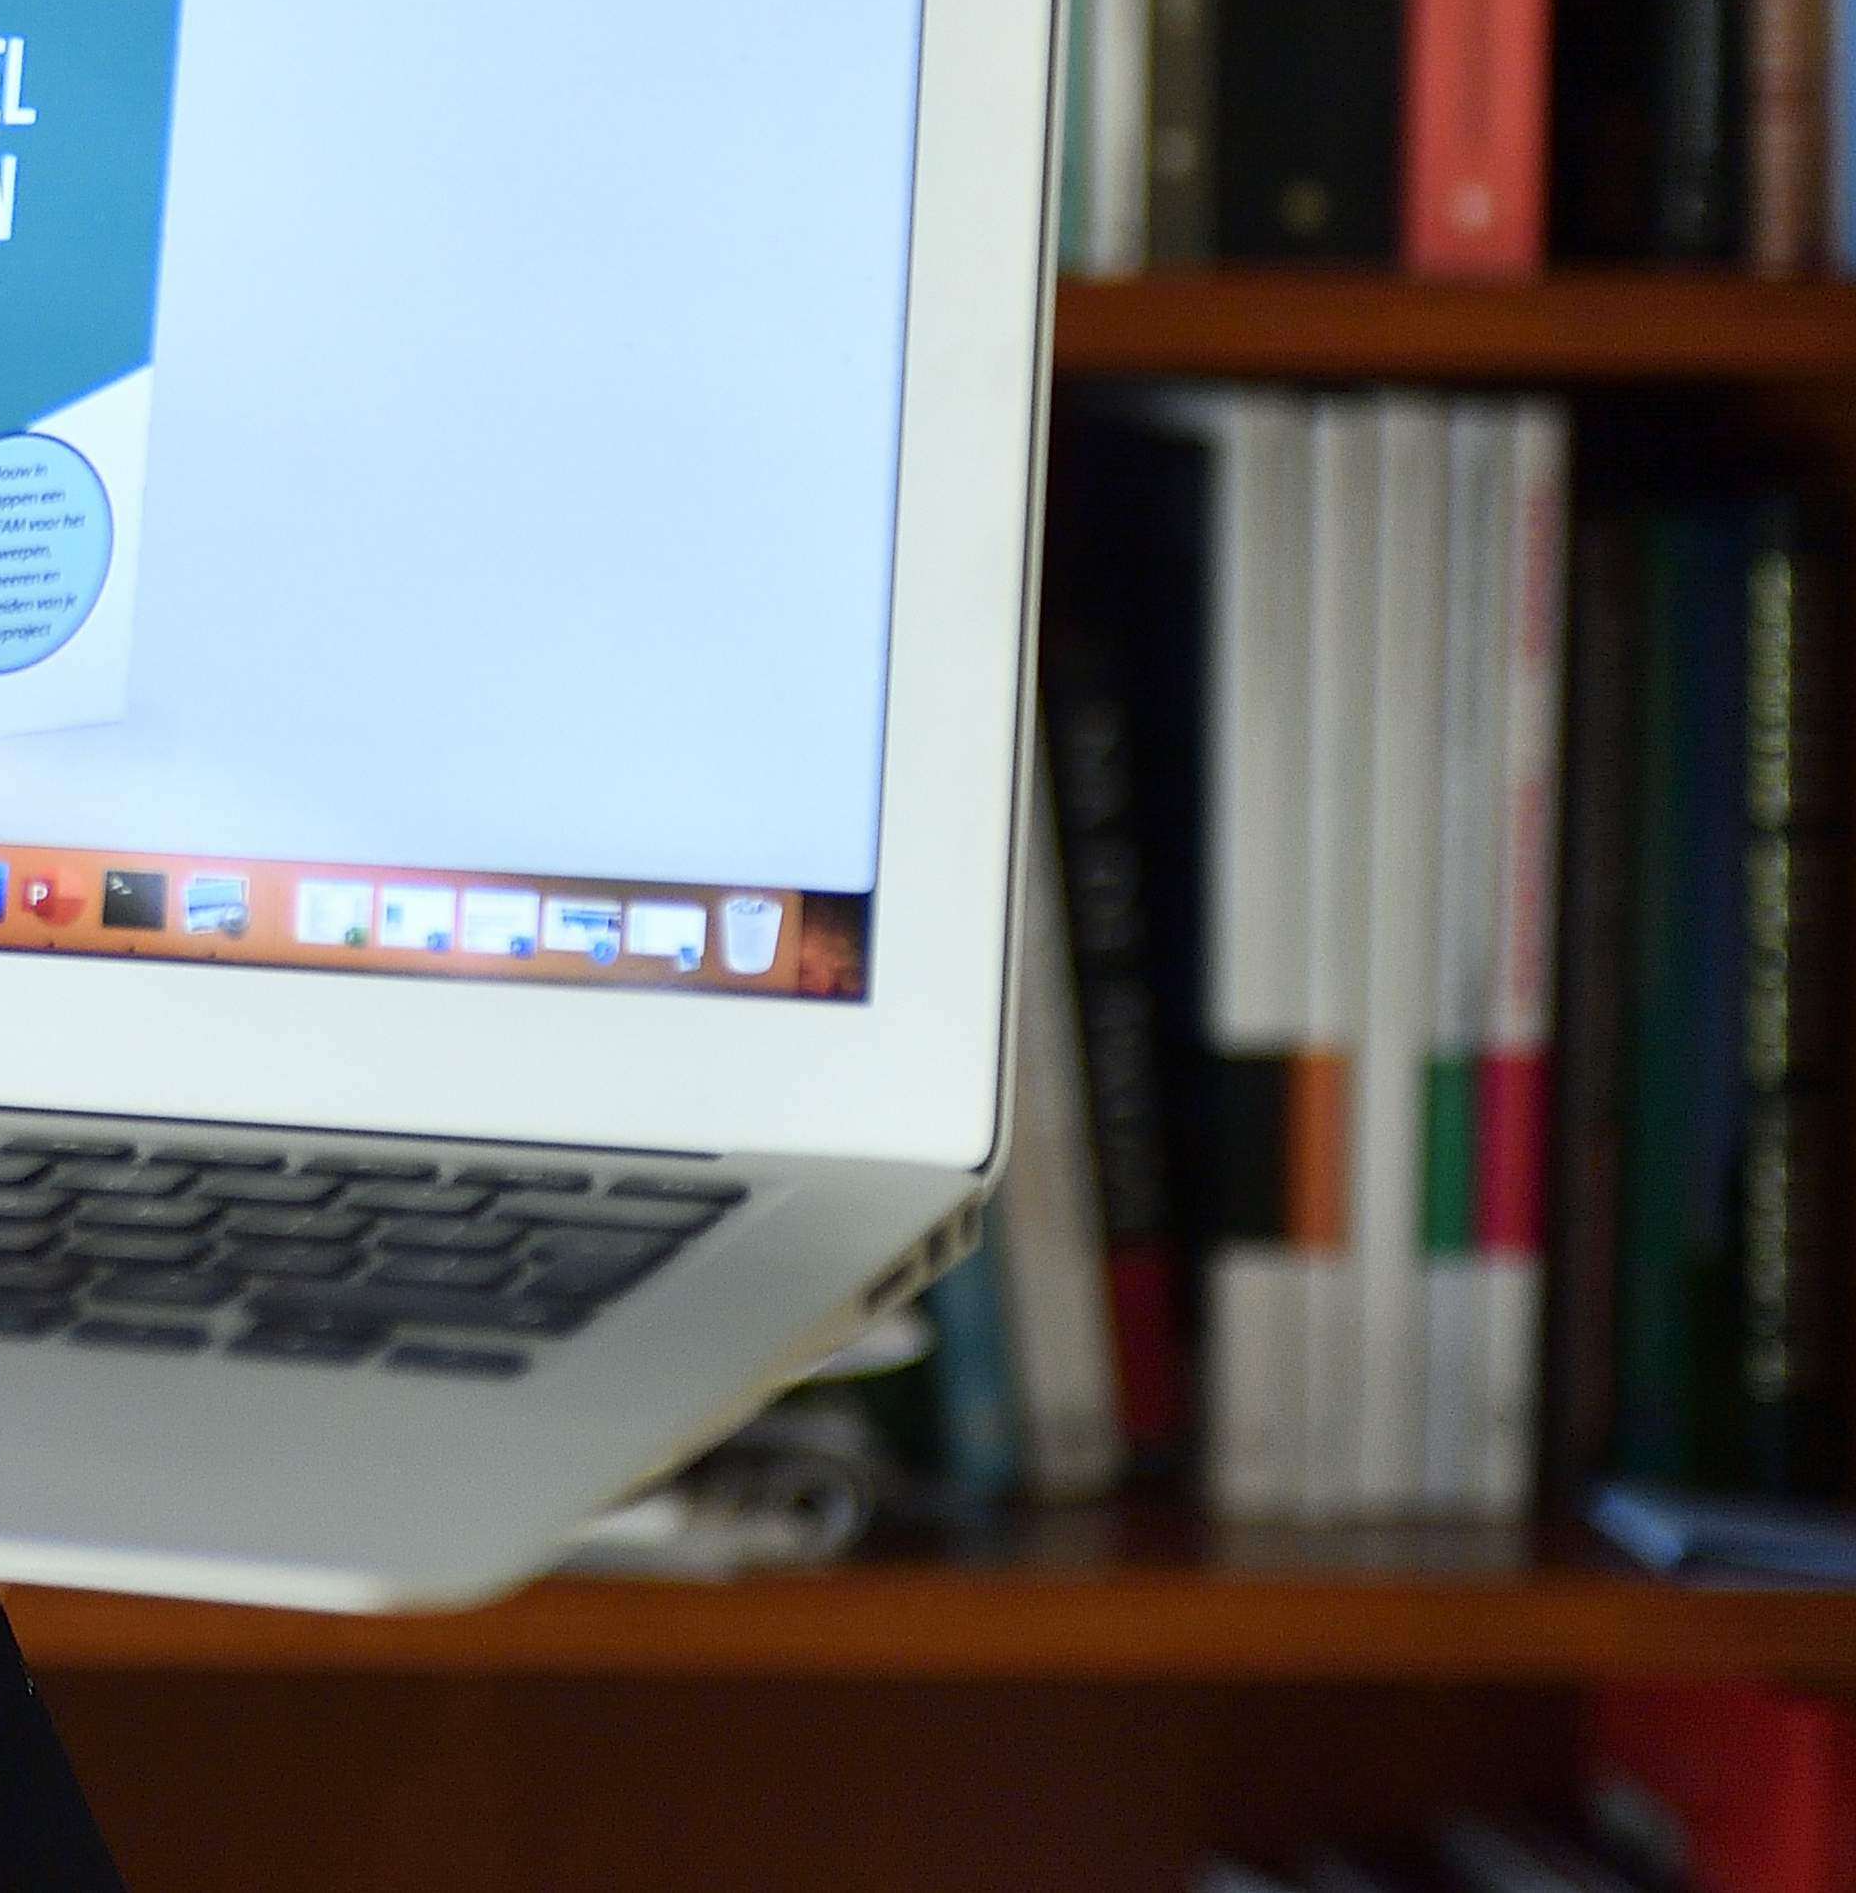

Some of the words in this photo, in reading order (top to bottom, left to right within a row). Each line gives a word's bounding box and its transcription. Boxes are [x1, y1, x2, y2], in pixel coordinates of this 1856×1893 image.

[29, 516, 63, 531] voor
[63, 514, 86, 527] het
[28, 881, 48, 907] P
